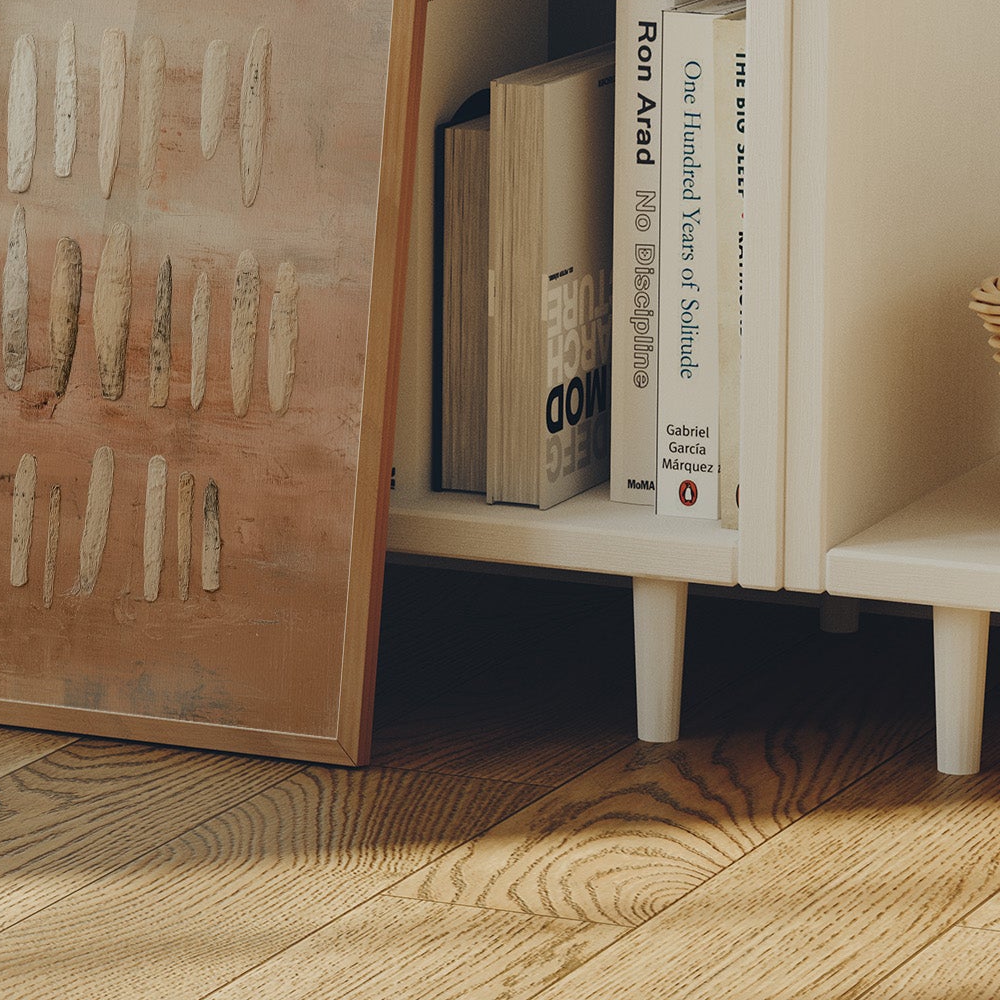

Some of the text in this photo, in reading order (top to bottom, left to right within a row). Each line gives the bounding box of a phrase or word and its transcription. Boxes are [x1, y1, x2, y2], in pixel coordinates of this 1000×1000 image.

[630, 20, 657, 389] Ron Arad No Discipline
[680, 60, 702, 379] One Hundred Years of Solitude
[666, 424, 710, 438] Gabriel
[668, 441, 706, 455] García
[662, 458, 713, 474] Márquez
[627, 479, 655, 491] MoMA
